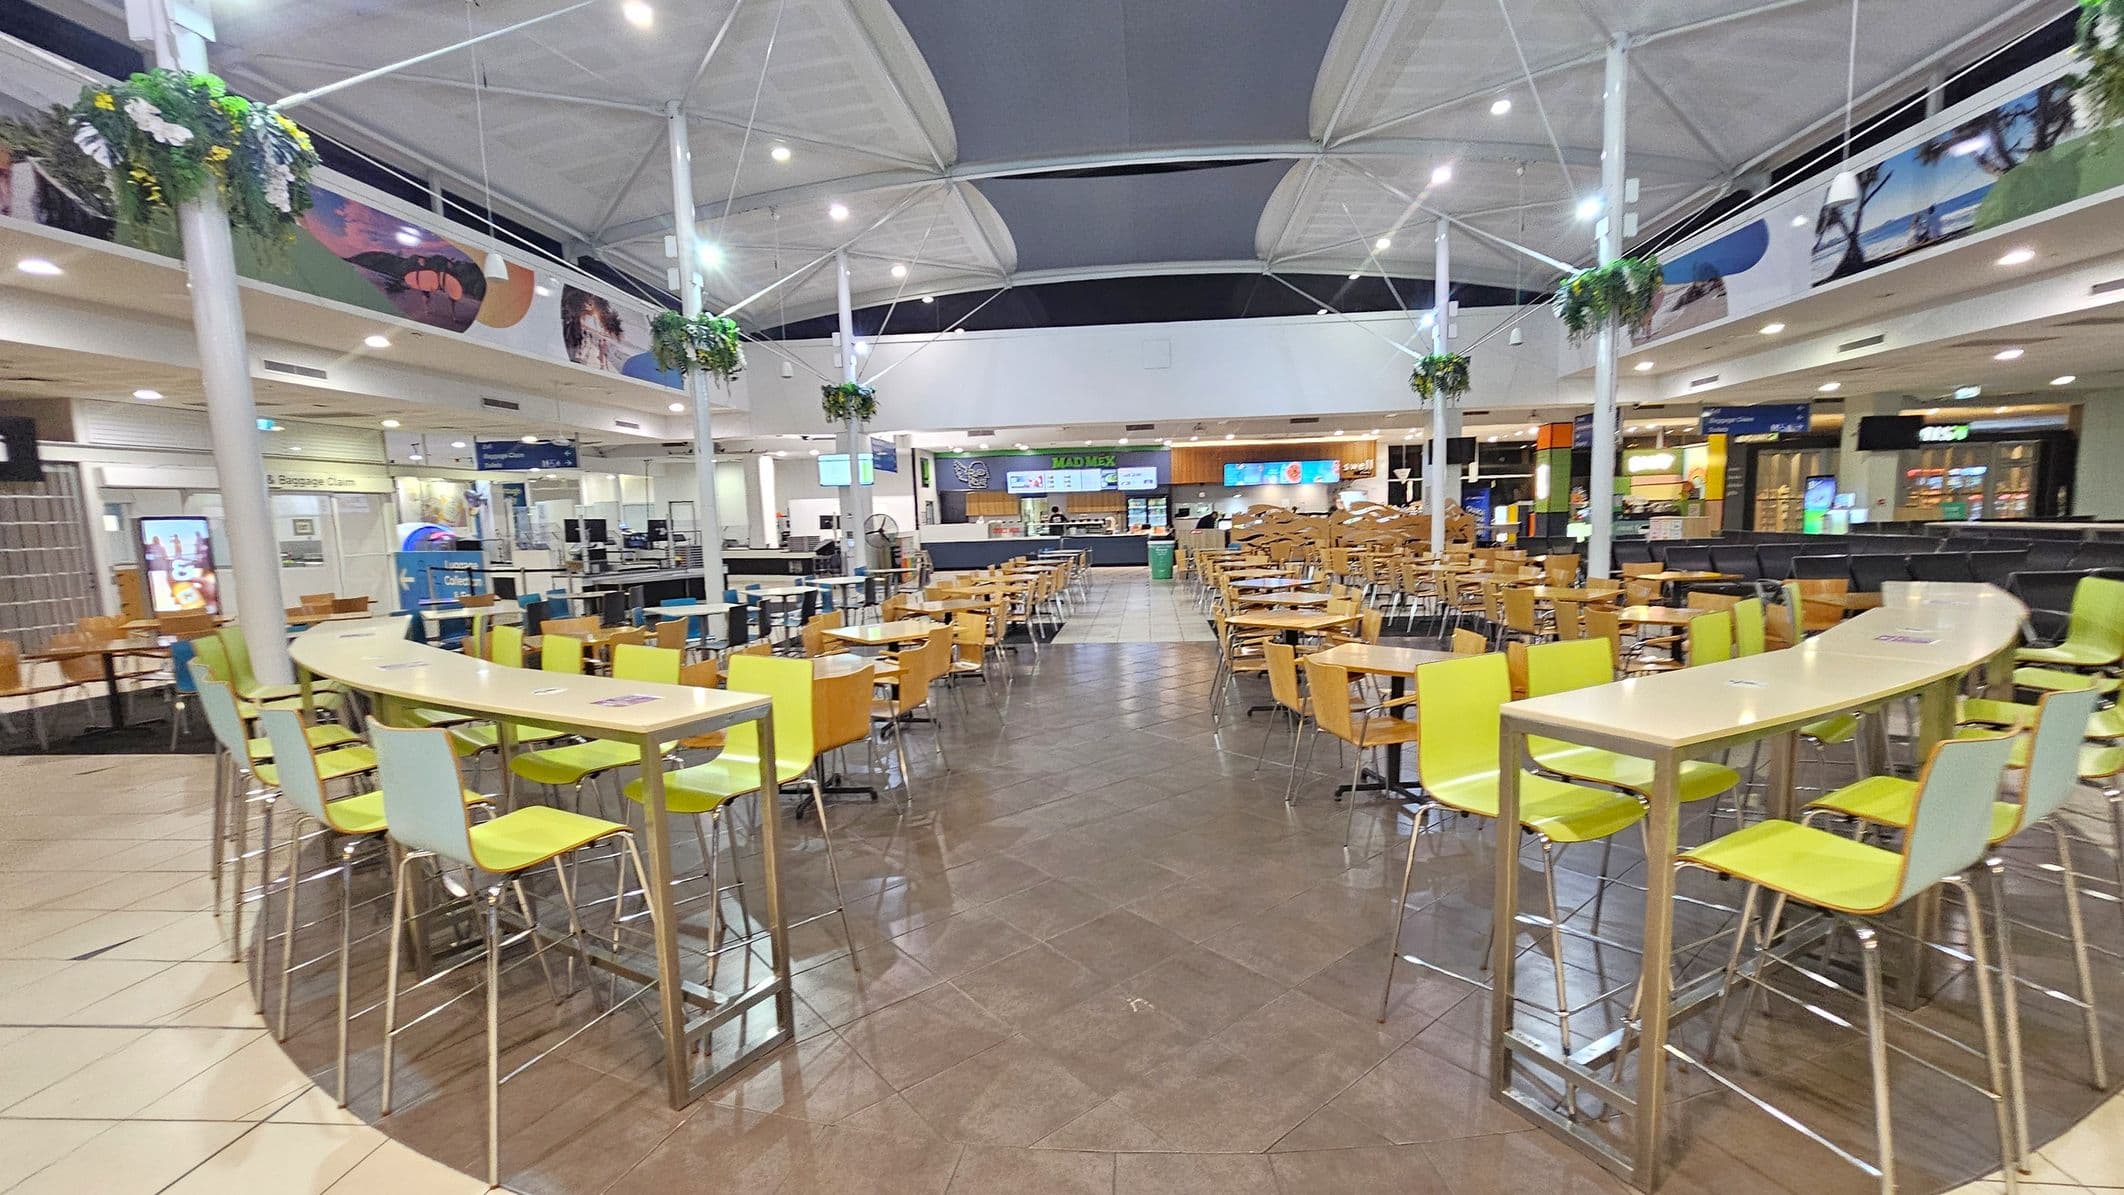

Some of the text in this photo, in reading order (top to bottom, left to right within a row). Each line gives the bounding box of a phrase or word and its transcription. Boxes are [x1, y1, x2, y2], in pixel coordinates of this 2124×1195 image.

[1052, 455, 1116, 468] MAD MEX
[1343, 459, 1373, 470] swell
[279, 474, 325, 488] Baggage
[327, 477, 356, 487] Claim
[444, 560, 479, 573] Luggage
[444, 576, 482, 587] Collecton
